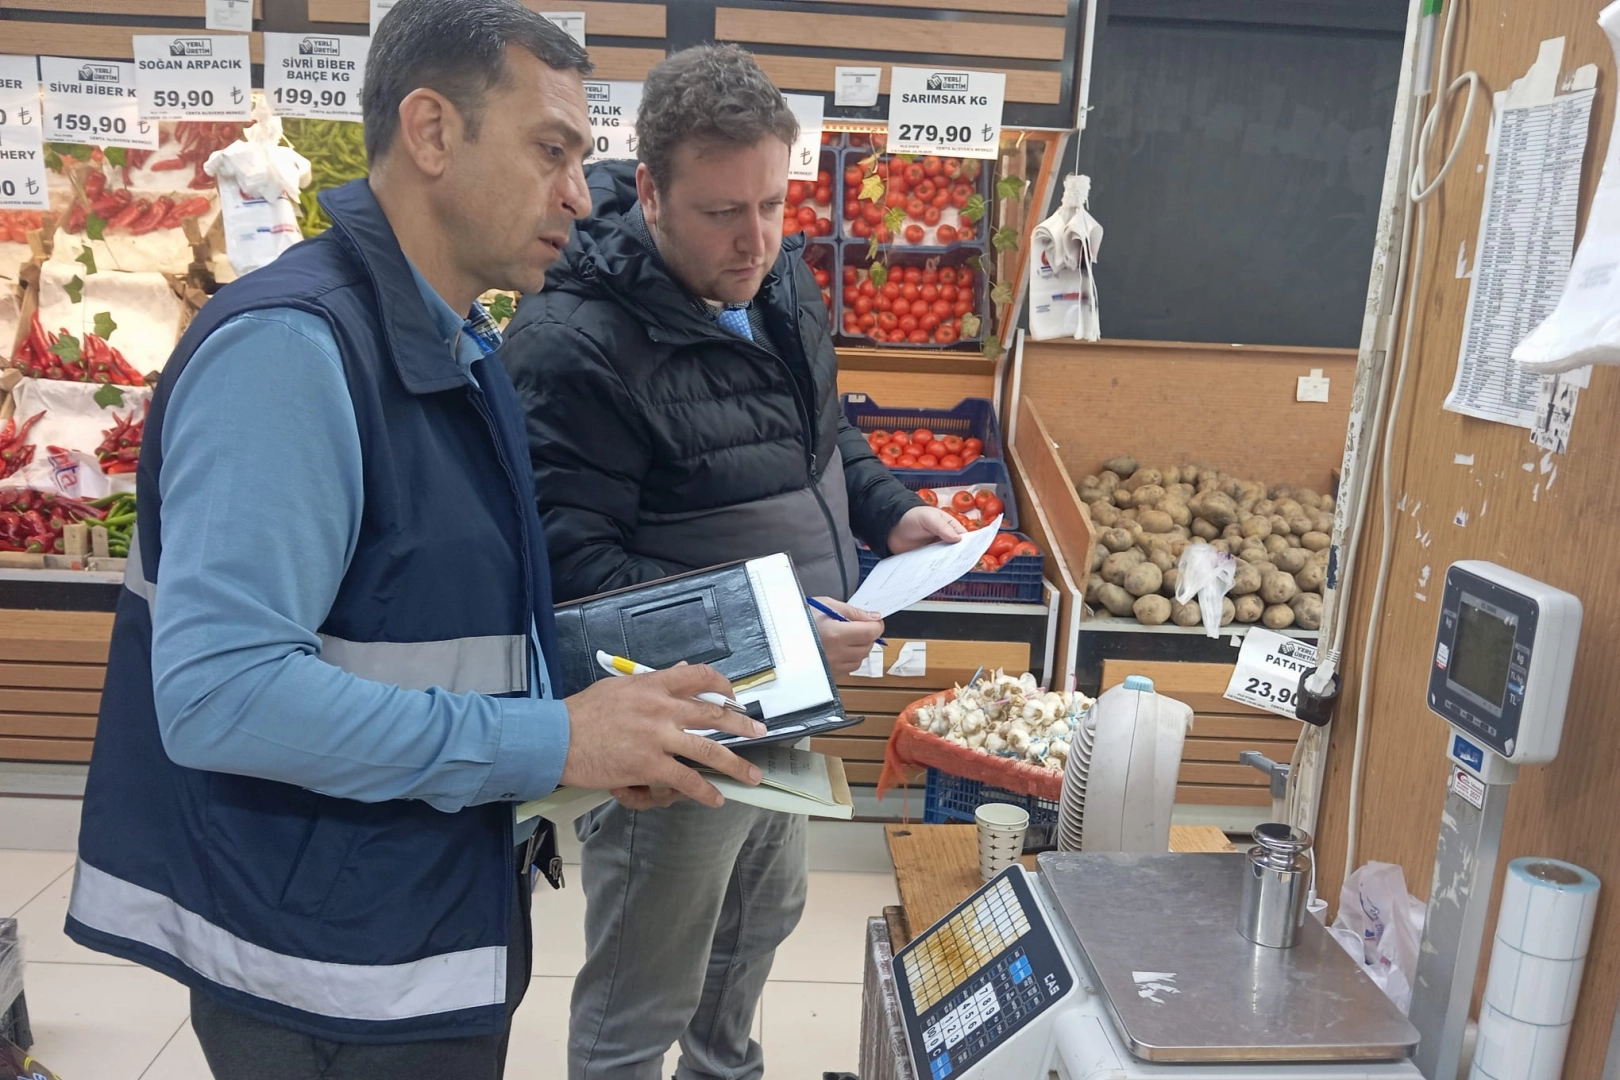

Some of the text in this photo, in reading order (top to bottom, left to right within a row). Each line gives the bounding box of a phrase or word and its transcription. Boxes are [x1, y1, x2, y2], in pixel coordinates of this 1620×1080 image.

[138, 58, 242, 70] SOĞAN ARPACIK
[282, 56, 356, 70] SİVRİ BİBER
[287, 70, 350, 82] BAHÇE KG
[50, 83, 137, 98] SİVRİ BİBER K
[154, 90, 214, 109] 59,90
[274, 88, 346, 108] 199,90
[902, 94, 988, 106] SARIMSAK KG
[54, 113, 126, 134] 159,90
[602, 118, 620, 127] KG
[898, 124, 972, 144] 279,90
[0, 150, 36, 160] HERY
[1297, 646, 1316, 657] YERLİ
[1266, 654, 1311, 674] PATAT
[1516, 652, 1525, 665] kg
[1510, 692, 1516, 706] TL
[1044, 973, 1060, 996] CAS
[978, 988, 988, 996] 7
[962, 1002, 971, 1010] 4
[982, 997, 992, 1006] 8
[964, 1011, 974, 1020] 5
[986, 1007, 995, 1016] 9
[944, 1016, 954, 1024] 1
[968, 1021, 978, 1030] 6
[926, 1026, 937, 1038] 00
[947, 1024, 956, 1034] 2
[930, 1038, 940, 1046] 0
[950, 1034, 960, 1043] 3
[932, 1048, 942, 1057] C
